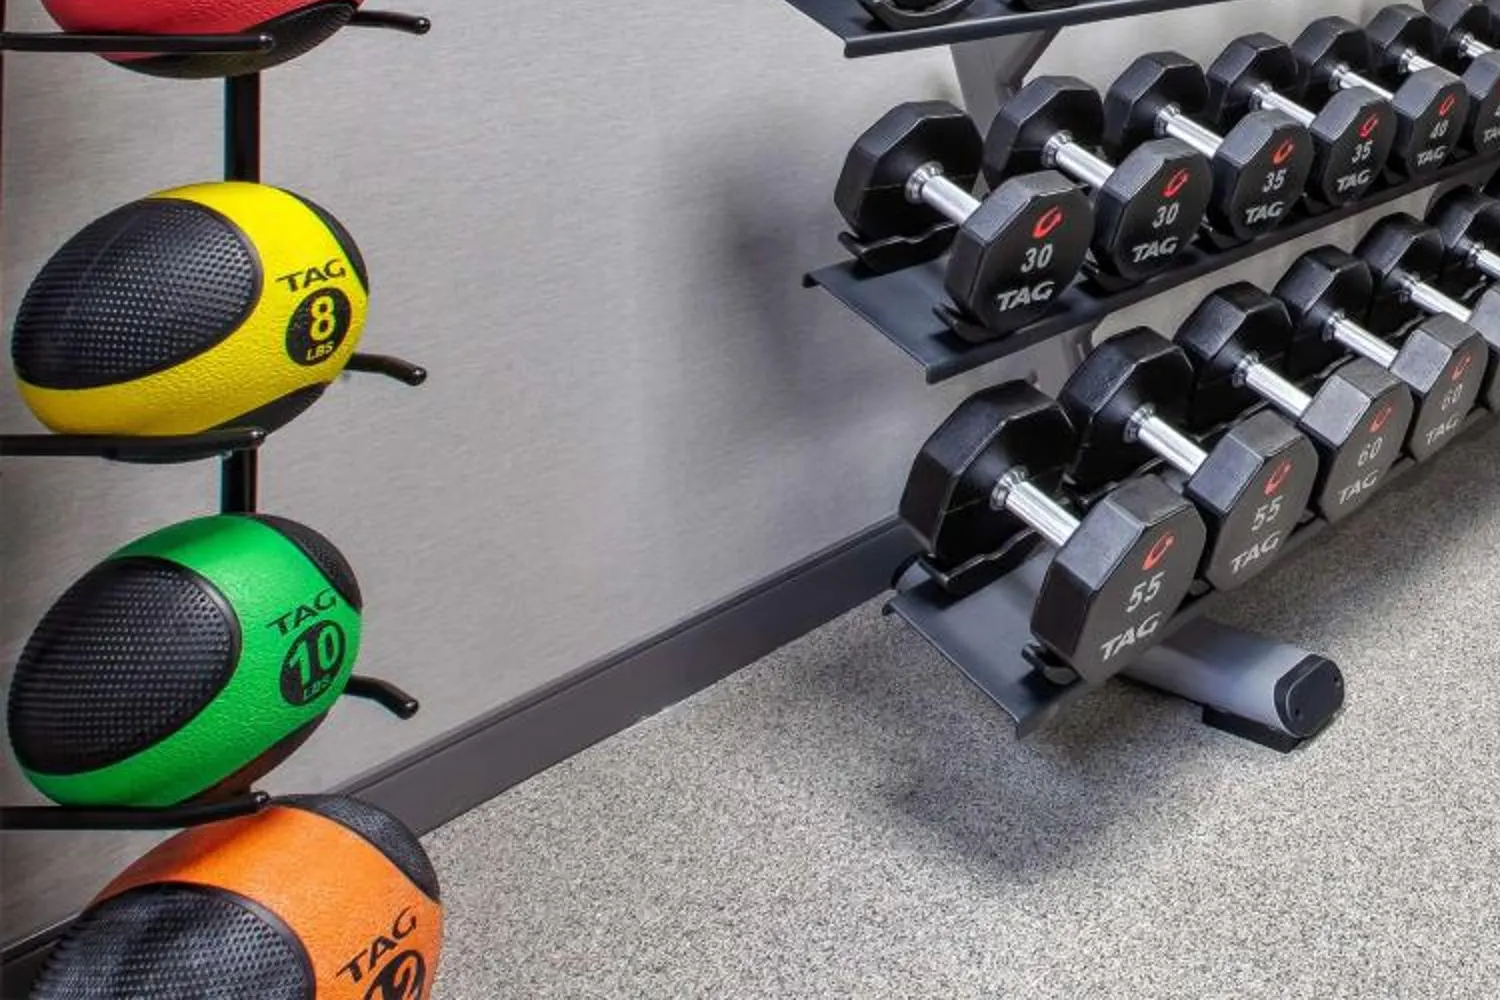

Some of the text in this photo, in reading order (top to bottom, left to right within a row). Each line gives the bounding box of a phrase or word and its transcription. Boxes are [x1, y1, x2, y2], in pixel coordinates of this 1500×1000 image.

[1430, 119, 1449, 139] 40
[1351, 140, 1374, 163] 35
[1417, 145, 1448, 167] TAG
[1262, 168, 1287, 193] 35
[1336, 169, 1373, 193] TAG
[1152, 202, 1180, 229] 30
[1244, 201, 1285, 225] TAG
[1021, 243, 1053, 273] 30
[1132, 236, 1179, 264] TAG
[275, 258, 346, 292] TAG
[997, 281, 1056, 312] TAG
[310, 295, 335, 341] 8
[1441, 383, 1463, 411] 60
[1425, 412, 1463, 446] TAG
[1356, 434, 1383, 468] 60
[1337, 468, 1380, 506] TAG
[1251, 494, 1284, 534] 55
[1230, 528, 1282, 576] TAG
[1126, 571, 1165, 614] 55
[265, 587, 337, 635] TAG
[1100, 609, 1162, 664] TAG
[289, 625, 340, 685] 10
[335, 906, 417, 983] TAG
